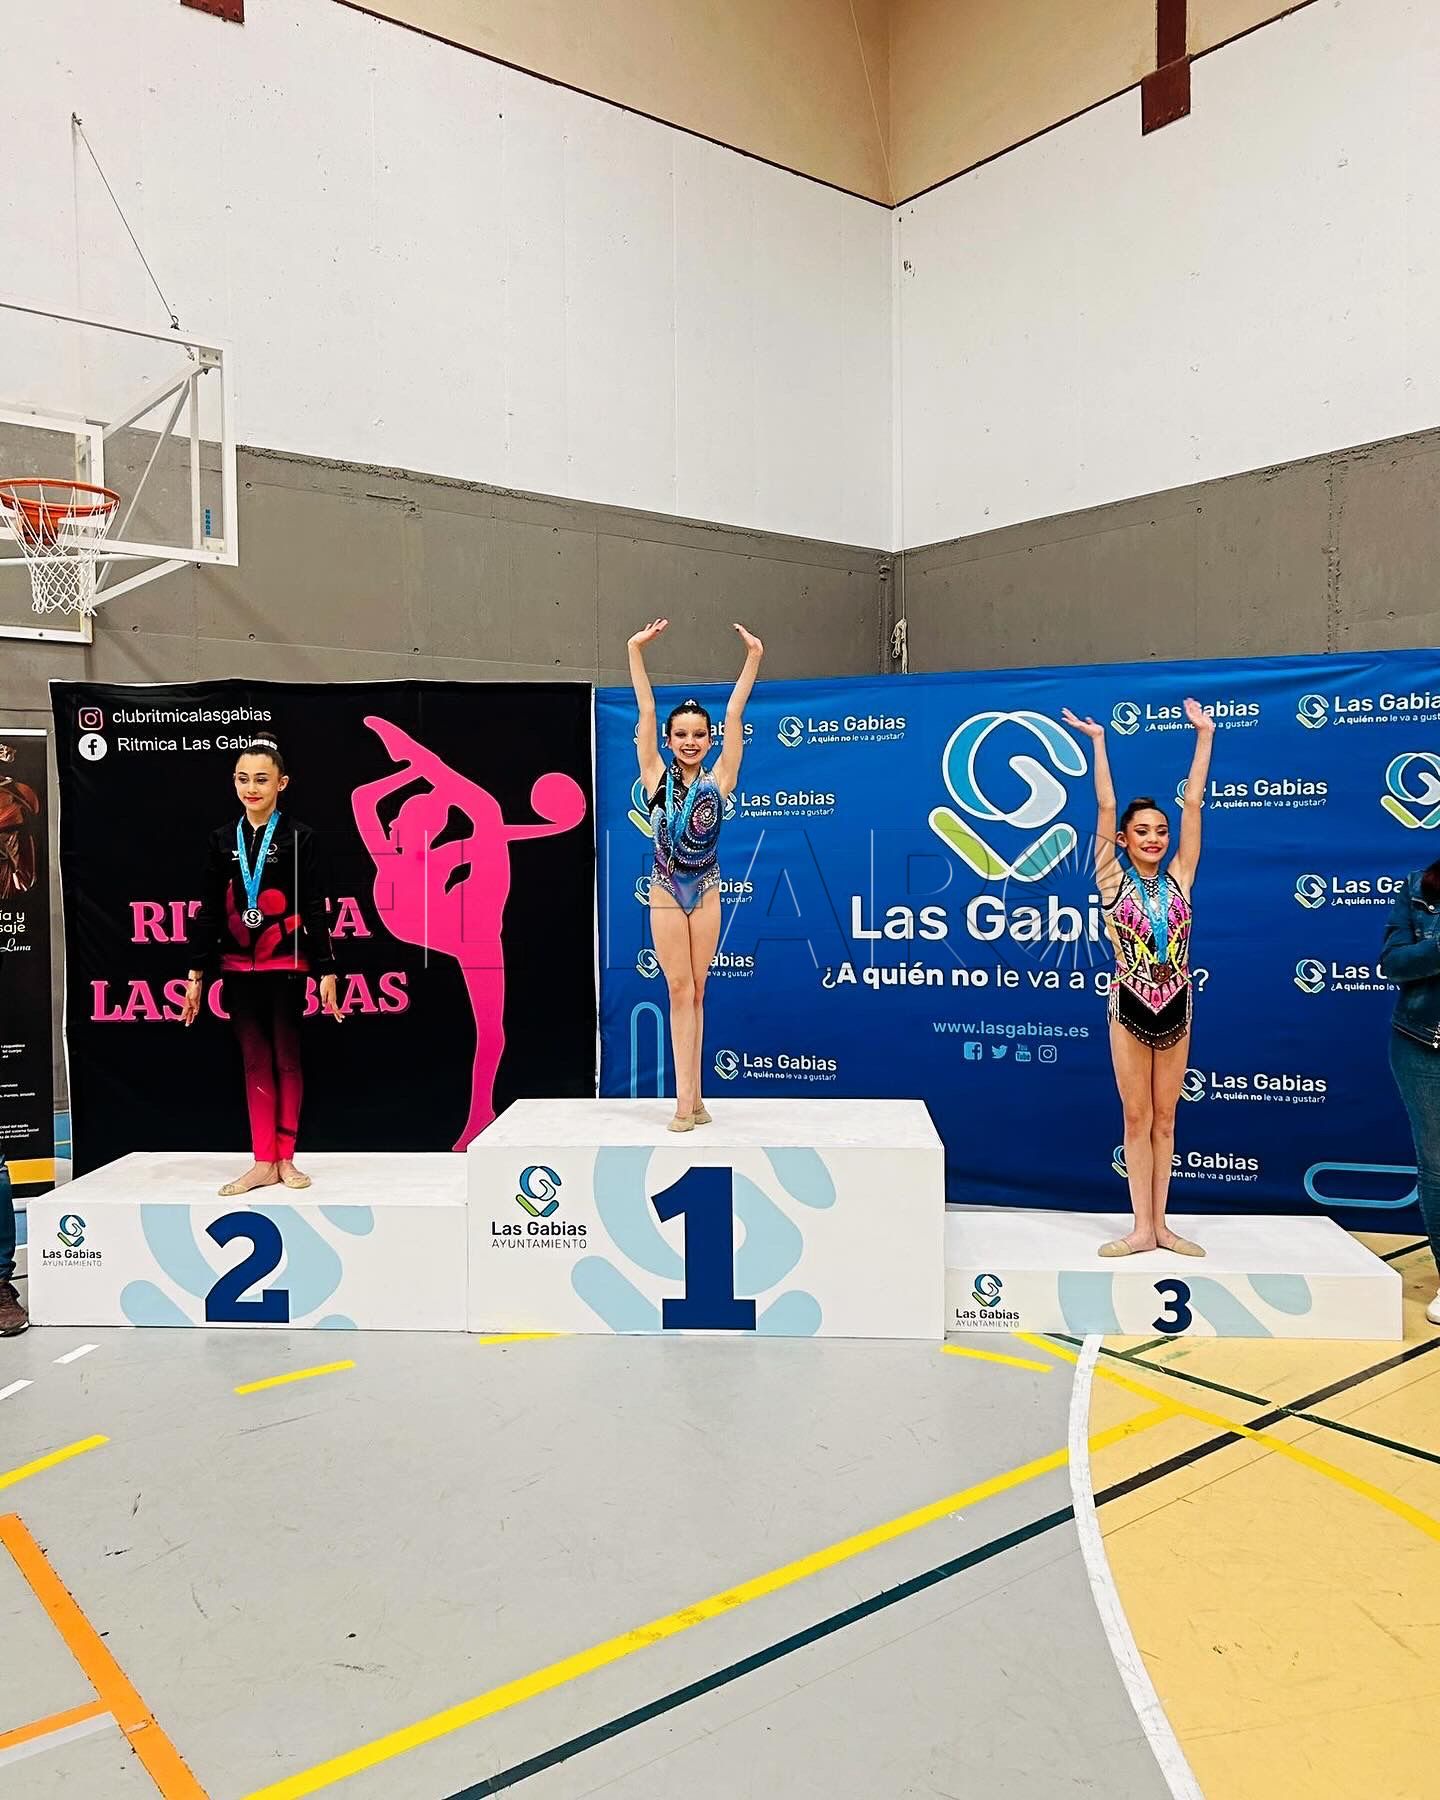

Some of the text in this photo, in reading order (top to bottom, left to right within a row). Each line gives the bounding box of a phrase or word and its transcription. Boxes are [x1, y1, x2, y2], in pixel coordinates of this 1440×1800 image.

[1335, 692, 1440, 712] Las Gabia
[113, 707, 272, 724] clubritmicalasgabias
[1146, 700, 1260, 719] Las abias
[808, 714, 905, 732] Las Gabias
[1157, 722, 1182, 731] quién
[1225, 719, 1258, 730] gustar?
[1347, 715, 1373, 724] quién
[1420, 713, 1440, 722] gust
[117, 735, 251, 751] Ritmica Las Gabi
[818, 735, 840, 743] quién
[876, 732, 904, 741] gustar?
[1211, 778, 1328, 796] Las Gabias
[741, 790, 835, 806] Las Gabias
[1223, 799, 1249, 808] quién
[1293, 798, 1326, 808] gustar?
[751, 809, 771, 818] quién
[807, 808, 834, 817] gustar?
[719, 879, 753, 893] bias
[1333, 877, 1371, 893] Las
[727, 896, 752, 904] gustar?
[1345, 897, 1371, 906] quién
[16, 911, 25, 922] y
[851, 894, 1110, 942] Las Gabi
[0, 921, 25, 934] saje
[711, 953, 754, 967] abias
[728, 970, 754, 978] gustar?
[822, 962, 858, 988] ¿A
[863, 961, 943, 989] quién
[952, 967, 988, 986] no
[997, 964, 1019, 988] le
[1027, 970, 1060, 989] va
[1069, 970, 1085, 989] a
[1332, 962, 1369, 979] Las
[1344, 982, 1371, 991] quién
[89, 979, 194, 1022] LAS
[933, 1020, 1089, 1039] www.lasgabias.es
[743, 1053, 837, 1071] Las Gabias
[753, 1071, 774, 1079] quién
[809, 1073, 836, 1081] gustar?
[1211, 1072, 1327, 1092] Las Gabias
[1223, 1091, 1249, 1100] quién
[1292, 1095, 1325, 1104] gustar?
[1187, 1151, 1259, 1170] Gabias
[1225, 1174, 1258, 1182] gustar?
[491, 1221, 587, 1236] Las Gabias
[491, 1238, 587, 1249] AYUNTAMIENTO
[651, 1166, 757, 1331] 1
[42, 1249, 102, 1259] Las Gabias
[205, 1211, 290, 1324] 2
[1151, 1278, 1193, 1334] 3
[955, 1308, 1020, 1320] Las Gabias
[955, 1319, 1020, 1328] AYUNTAMIENTO
